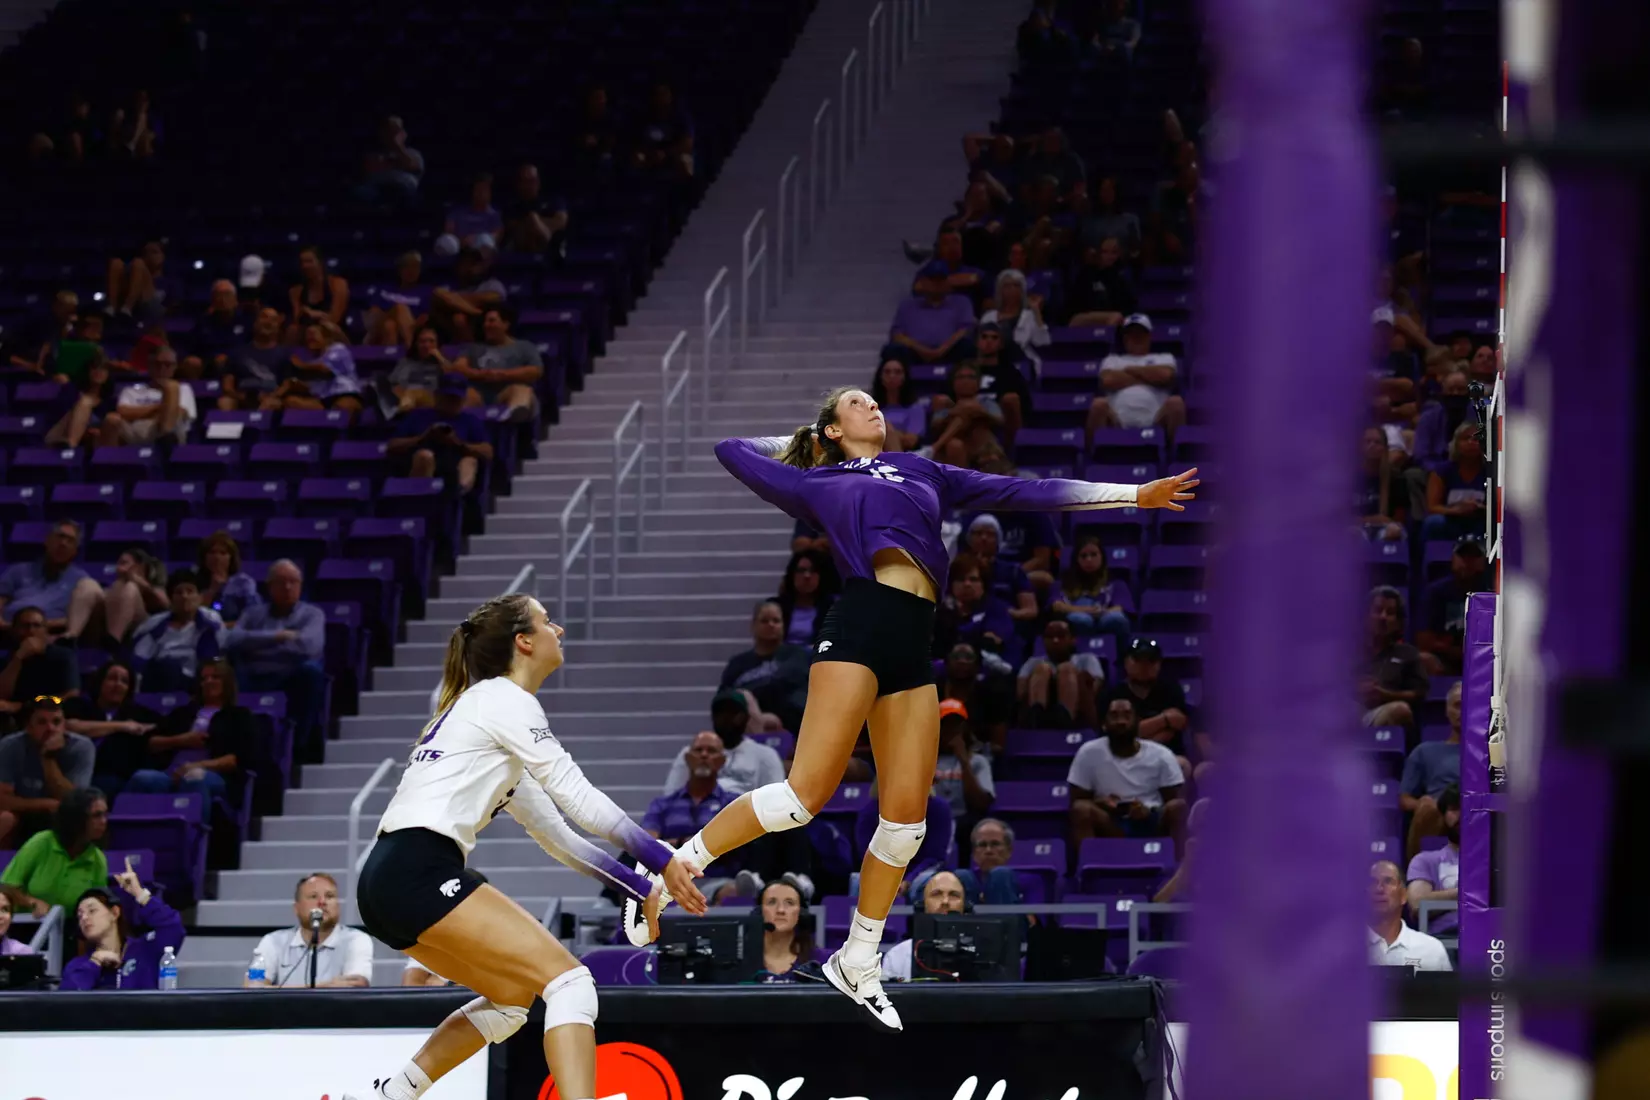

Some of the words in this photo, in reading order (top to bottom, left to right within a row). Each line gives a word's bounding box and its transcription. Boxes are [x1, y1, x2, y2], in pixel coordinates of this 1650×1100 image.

[408, 749, 444, 766] ATS
[1487, 939, 1505, 1000] spors
[1487, 1005, 1506, 1081] imports
